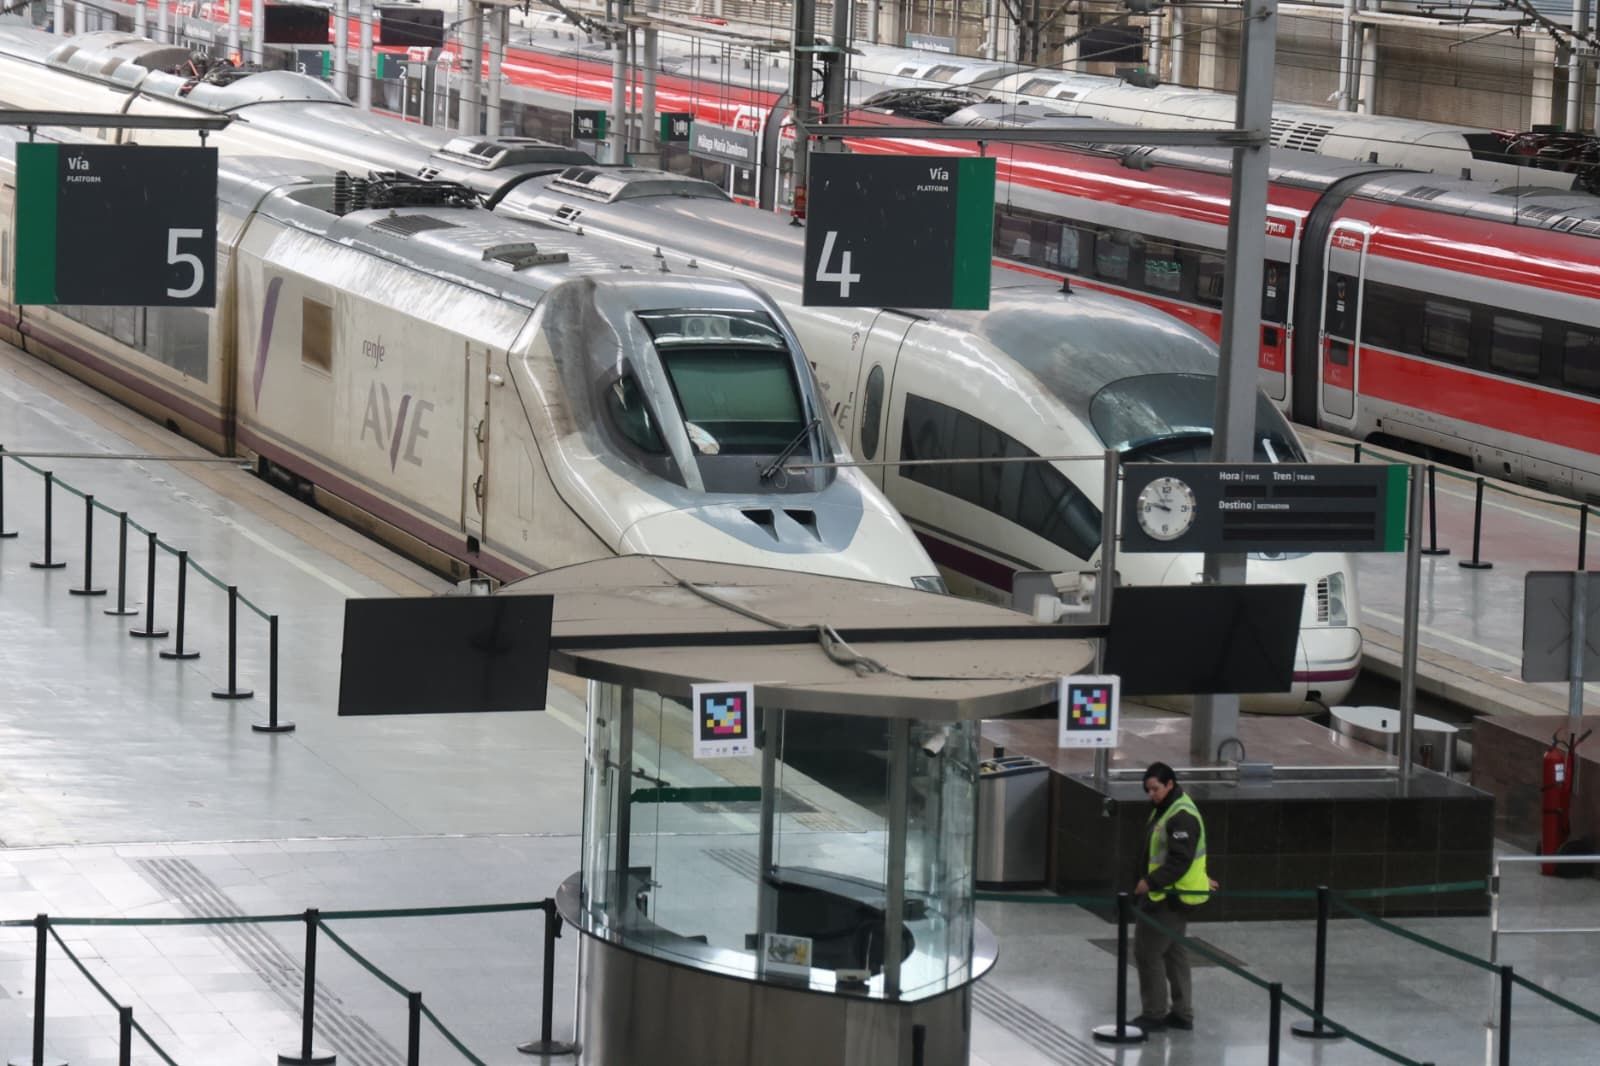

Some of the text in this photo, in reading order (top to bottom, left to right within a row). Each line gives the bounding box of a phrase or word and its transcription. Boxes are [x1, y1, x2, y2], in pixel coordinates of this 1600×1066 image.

[299, 62, 306, 75] 3
[399, 65, 407, 79] 2
[68, 156, 90, 170] Vía
[66, 175, 101, 183] PLATFORM
[929, 167, 949, 181] Vía
[917, 184, 949, 193] PLATFORM
[167, 228, 204, 298] 5
[815, 231, 861, 298] 4
[362, 334, 385, 368] renfe
[360, 379, 435, 475] AVE
[1219, 471, 1240, 481] Hora
[1273, 471, 1292, 481] Tren
[1218, 500, 1252, 510] Destino
